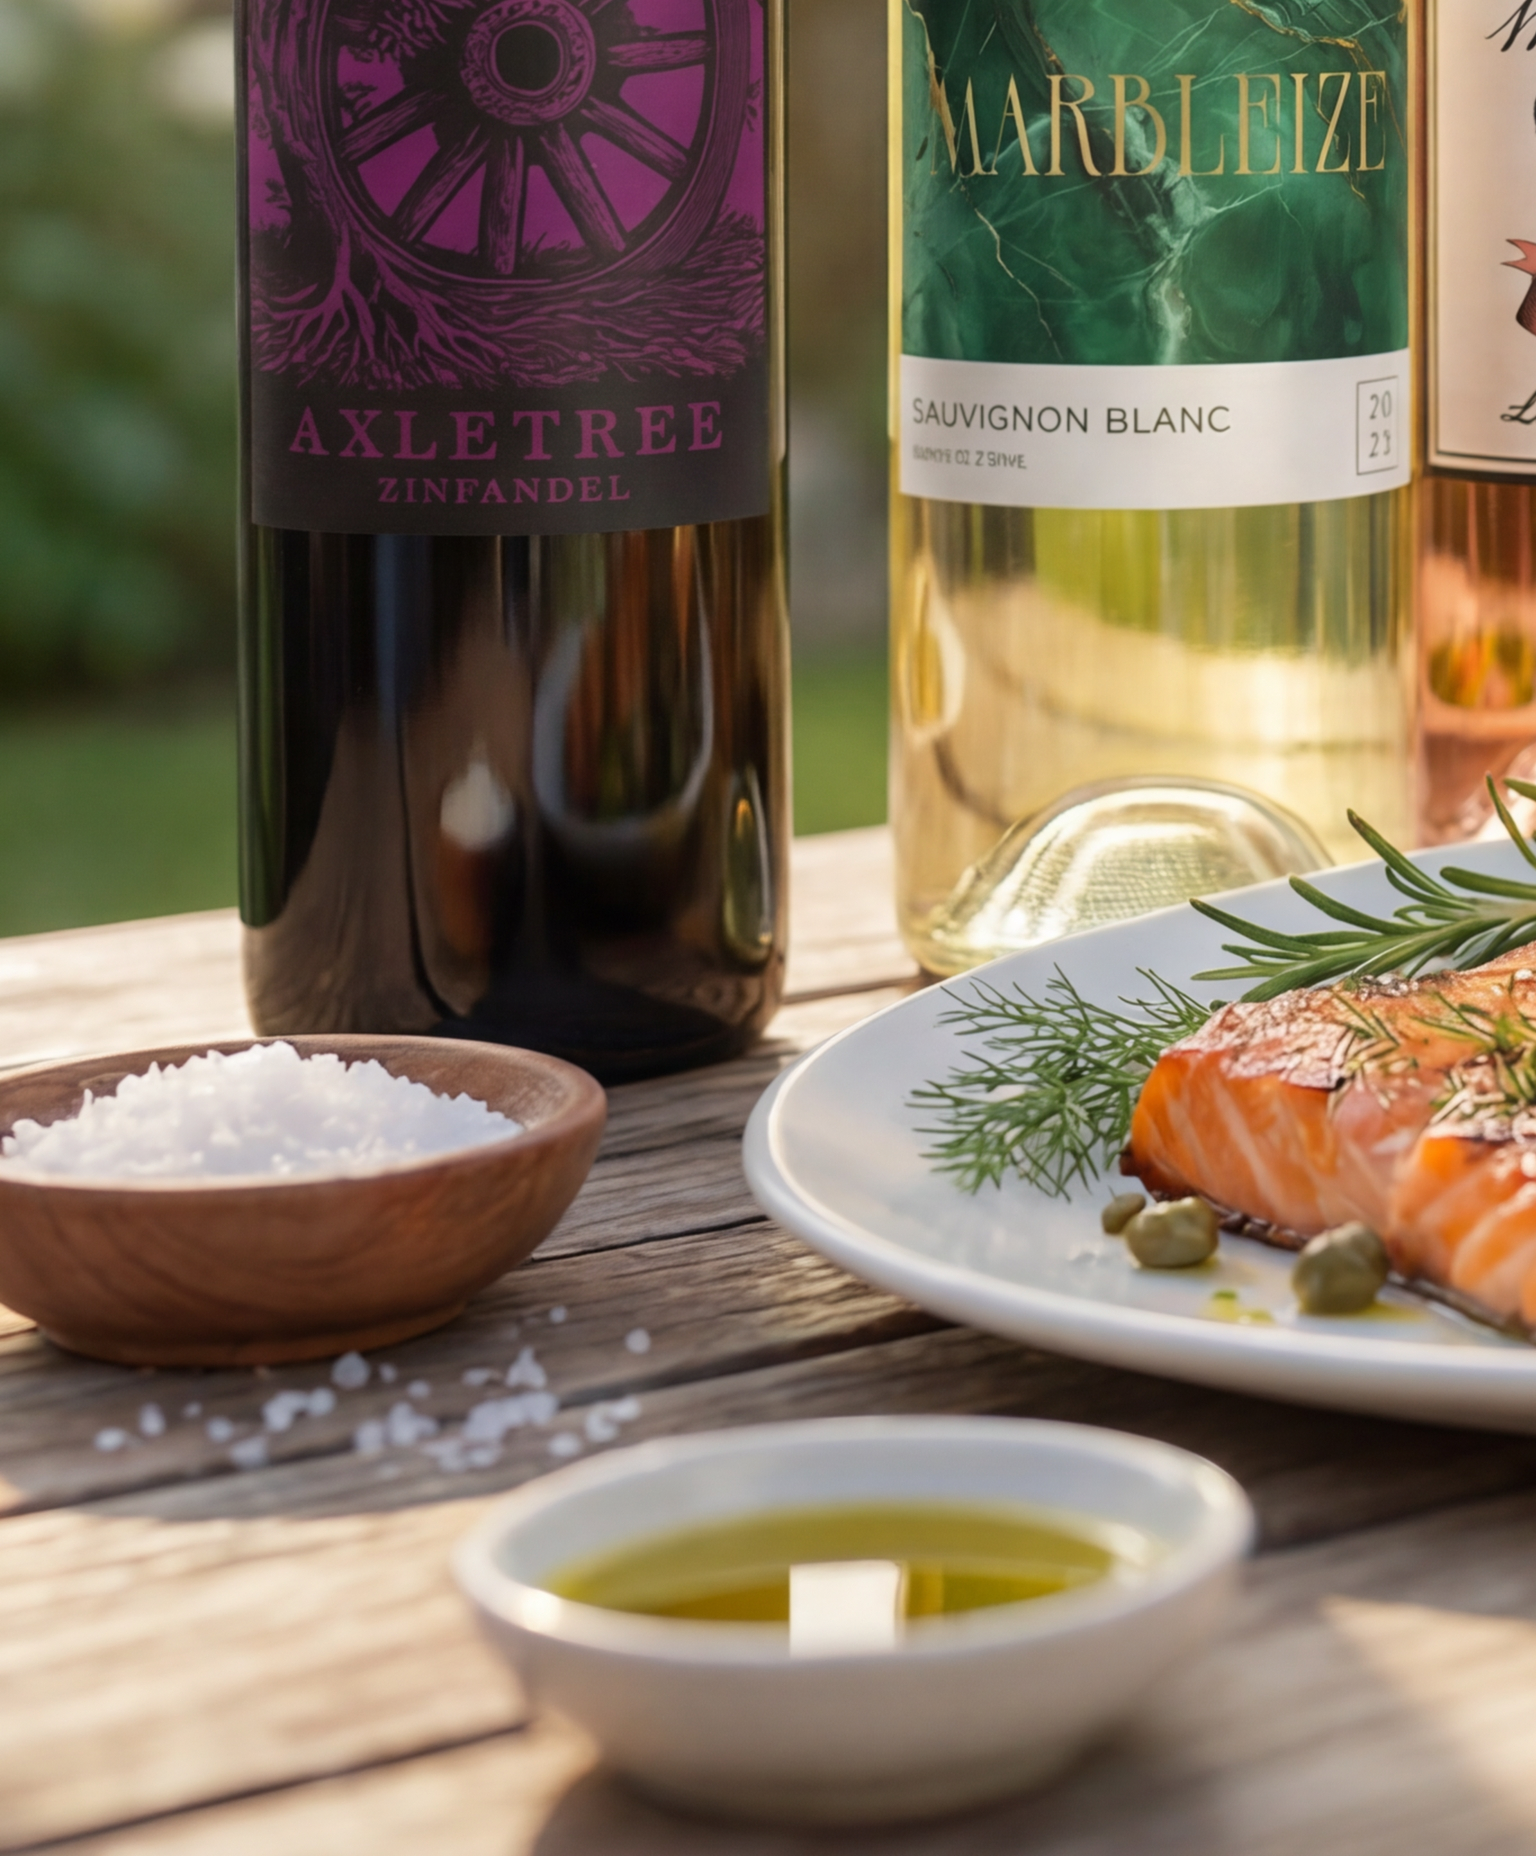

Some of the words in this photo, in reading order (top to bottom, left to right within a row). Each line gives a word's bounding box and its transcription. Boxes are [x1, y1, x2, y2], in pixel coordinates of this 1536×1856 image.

[930, 70, 1388, 178] MARBLEIZE
[912, 397, 1089, 434] SAUVIGNON
[1106, 405, 1232, 435] BLANC
[1369, 389, 1393, 420] 20
[288, 400, 724, 461] AXLETREE
[377, 474, 631, 505] ZINFANDEL
